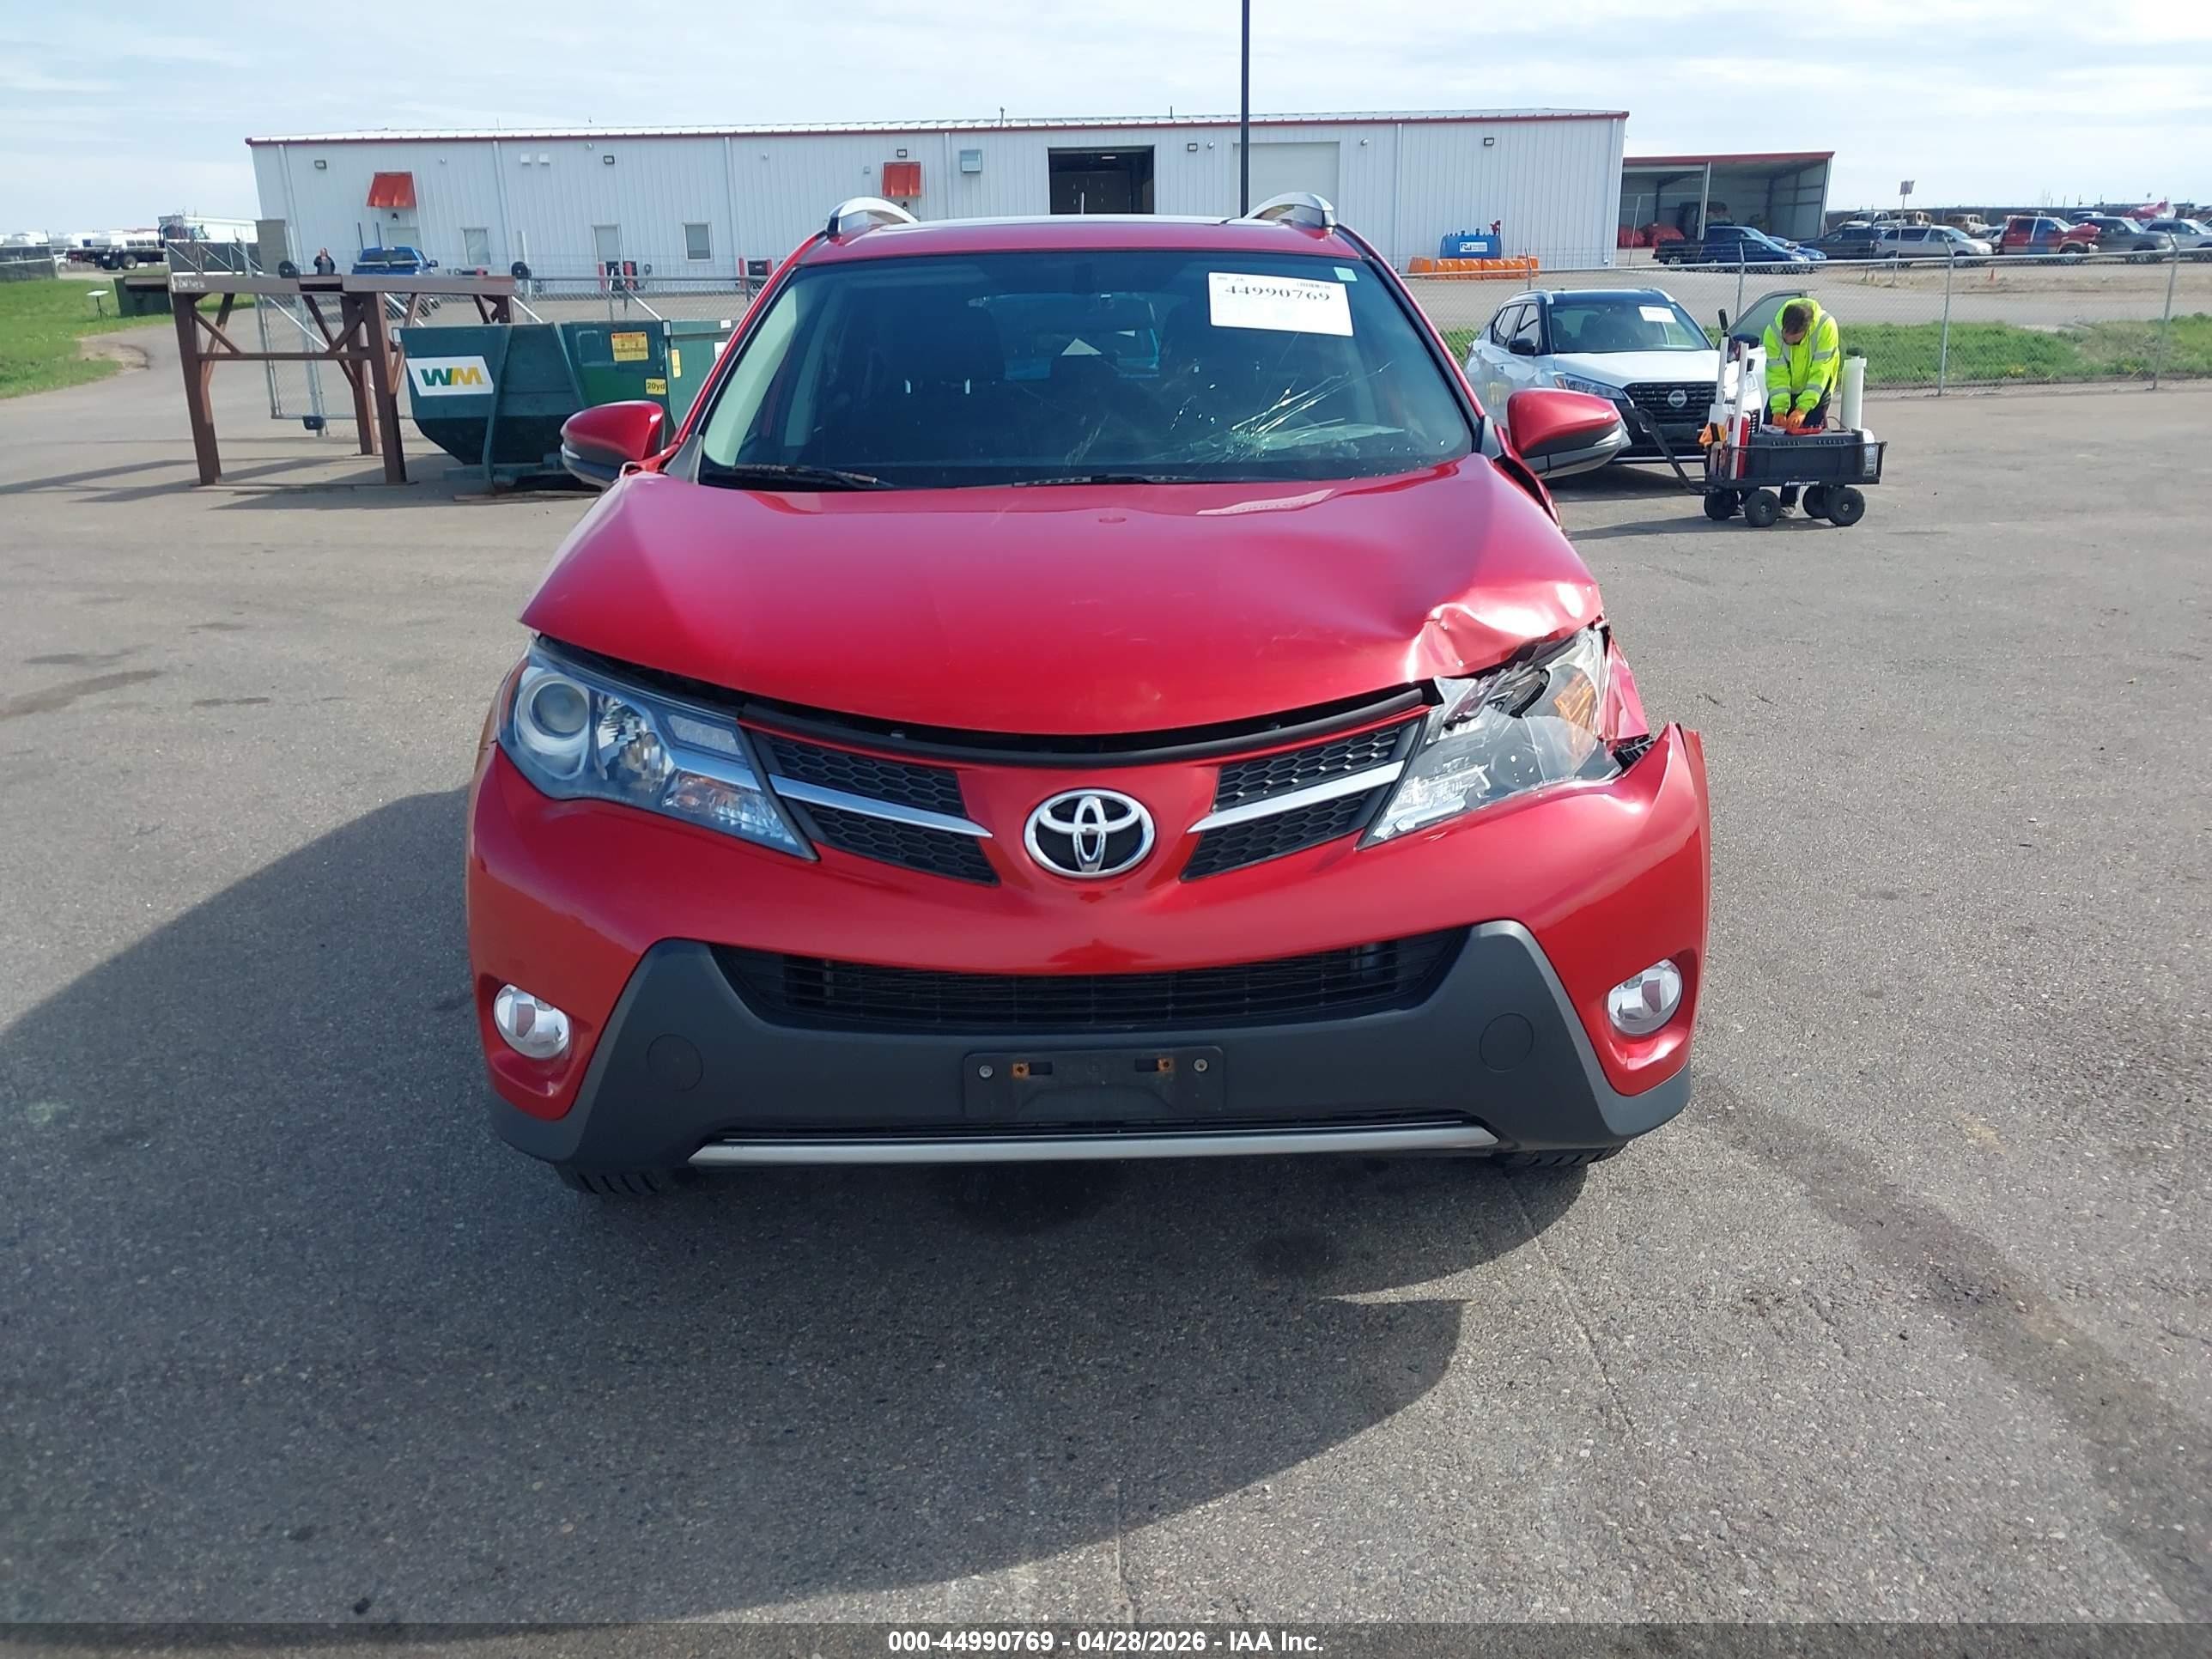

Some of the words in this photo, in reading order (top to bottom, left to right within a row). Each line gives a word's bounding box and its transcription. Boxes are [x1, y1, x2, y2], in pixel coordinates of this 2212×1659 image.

[1225, 285, 1330, 301] 44990769
[420, 367, 483, 386] WM
[647, 382, 665, 392] 20yd
